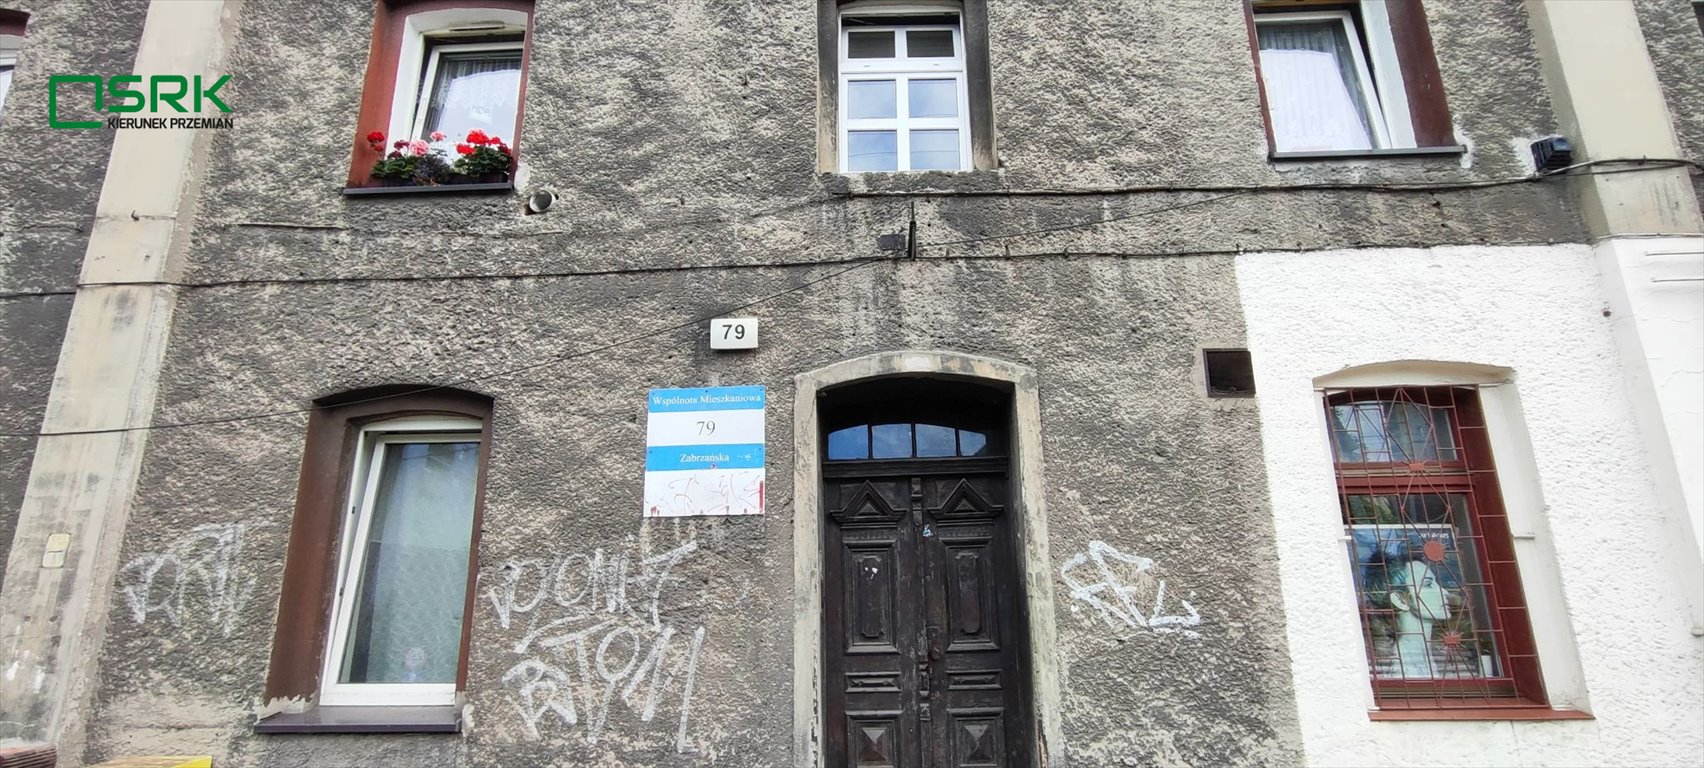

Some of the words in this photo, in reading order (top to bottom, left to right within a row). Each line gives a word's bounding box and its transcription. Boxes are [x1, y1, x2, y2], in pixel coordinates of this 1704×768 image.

[721, 324, 746, 340] 79
[653, 396, 698, 407] Wspólnota
[700, 394, 762, 404] Mieszkaniowa
[696, 420, 716, 437] 79
[679, 452, 730, 463] Zabrzańska
